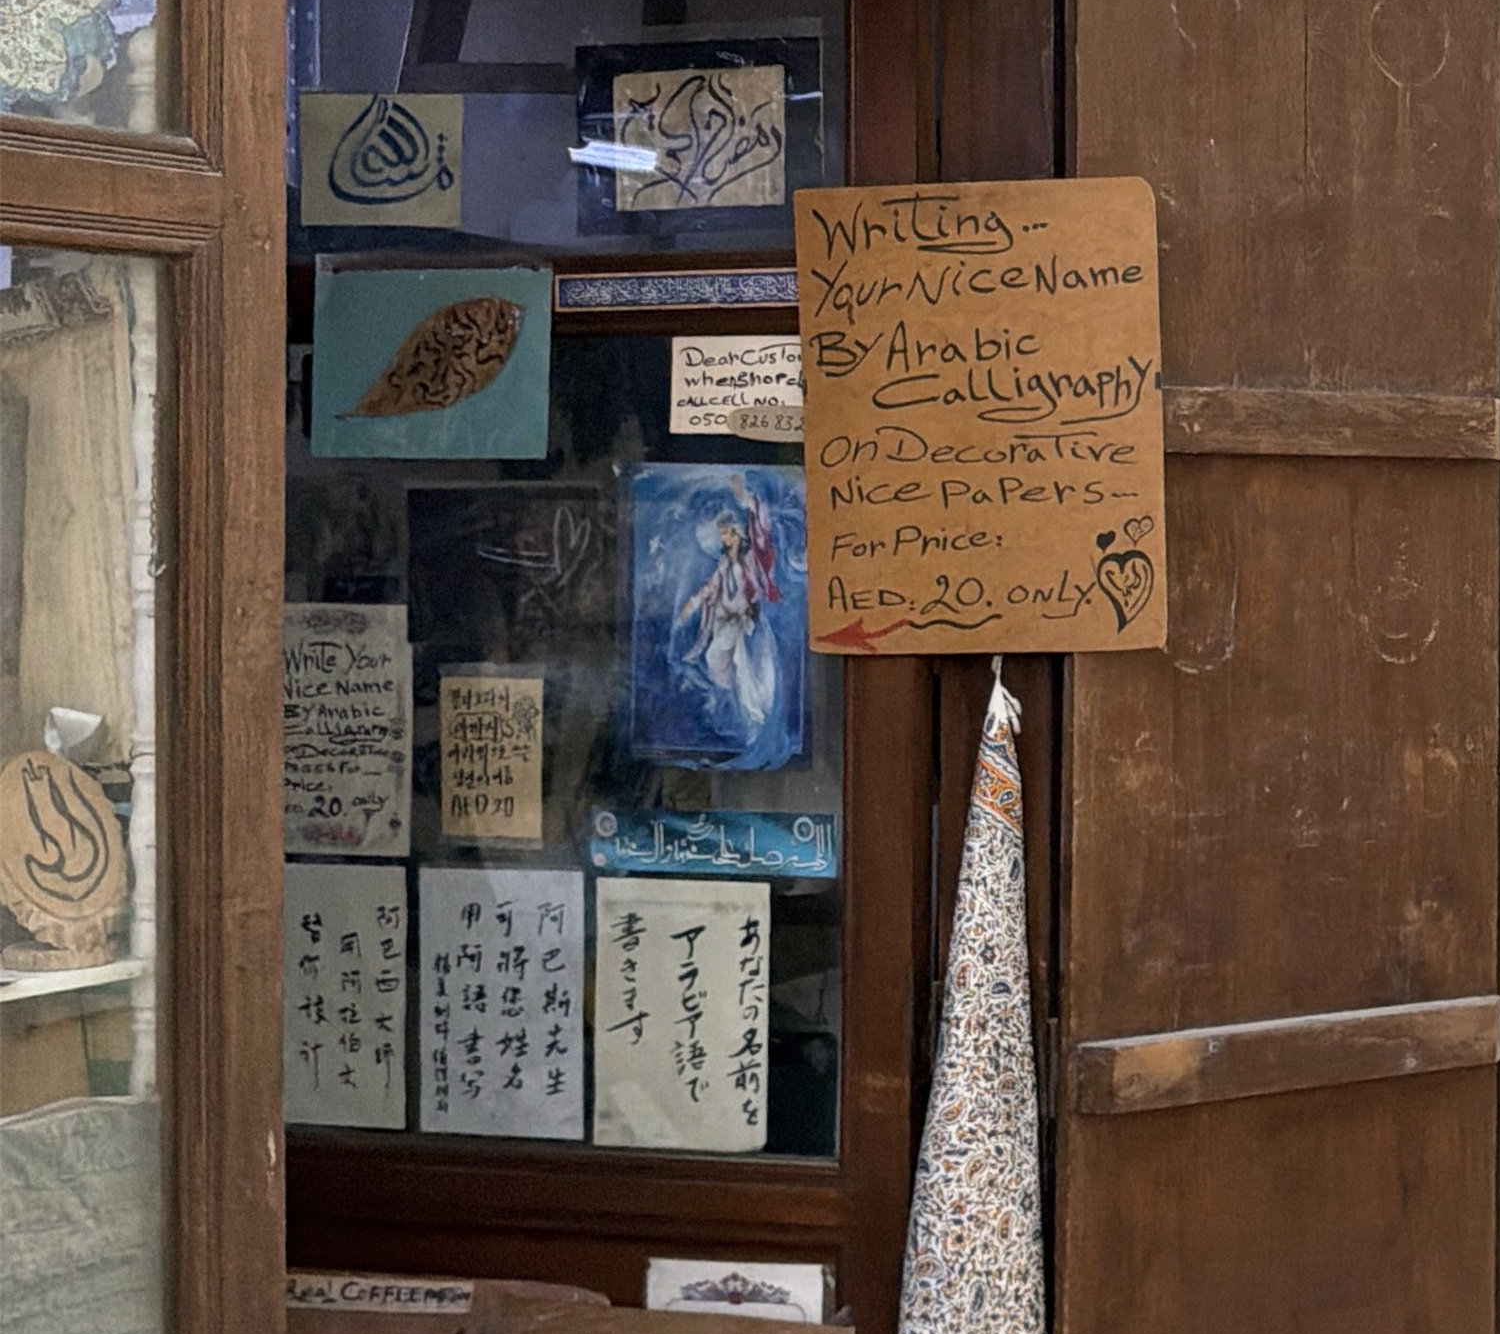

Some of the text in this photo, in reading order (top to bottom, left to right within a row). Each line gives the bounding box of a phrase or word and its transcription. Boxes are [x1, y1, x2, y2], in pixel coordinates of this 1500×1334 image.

[811, 260, 902, 324] Your
[906, 261, 1029, 305] Nice
[1035, 254, 1144, 295] Name
[680, 347, 740, 366] Dear
[809, 320, 1041, 378] By Arabic
[689, 413, 805, 431] 050 826 832
[820, 435, 878, 468] On
[830, 476, 931, 510] Nice
[831, 525, 1003, 561] For Price:
[336, 680, 394, 696] Name
[537, 901, 571, 1096] 阿巴斯先生
[606, 911, 651, 1046] 書きます
[669, 924, 709, 1103] アラビア語で
[726, 916, 765, 1126] あなたの名前を
